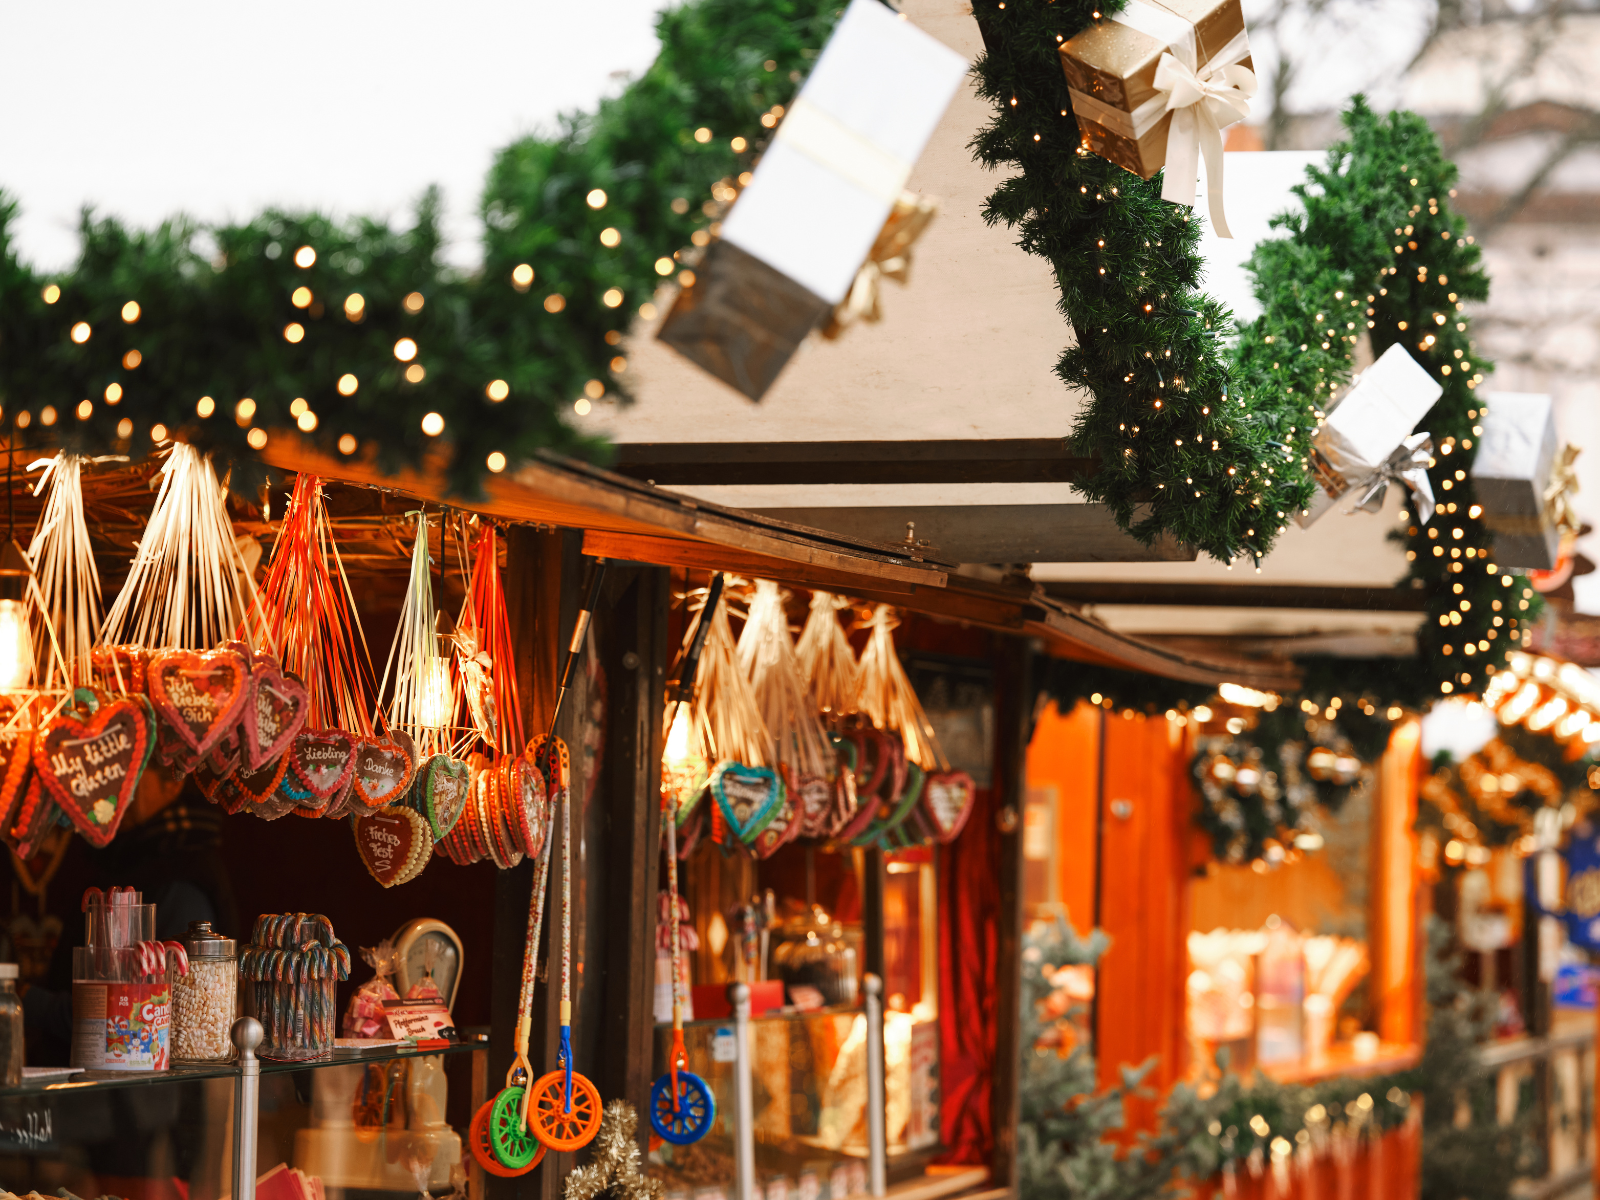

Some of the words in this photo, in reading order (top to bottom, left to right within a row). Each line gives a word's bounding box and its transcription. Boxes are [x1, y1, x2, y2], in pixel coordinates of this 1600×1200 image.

[51, 752, 88, 781] My
[83, 733, 132, 766] little
[304, 746, 348, 764] Liebling
[364, 757, 394, 777] Danke
